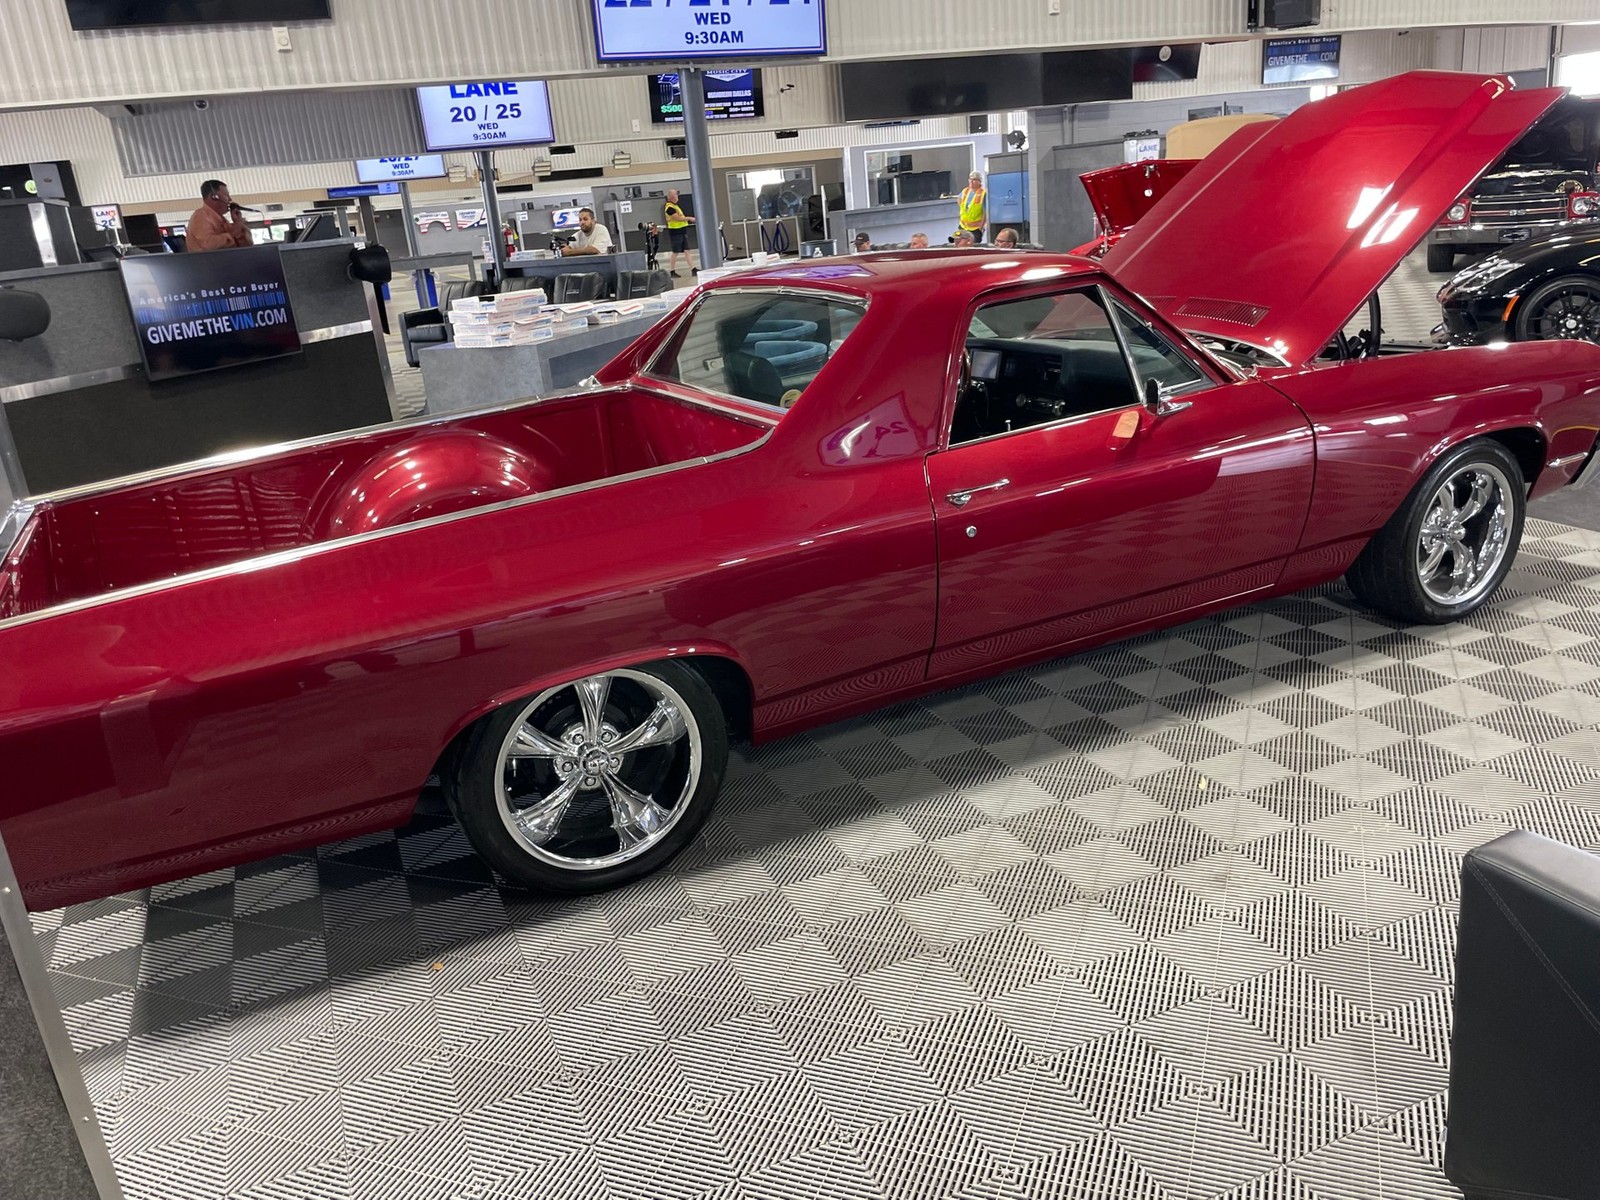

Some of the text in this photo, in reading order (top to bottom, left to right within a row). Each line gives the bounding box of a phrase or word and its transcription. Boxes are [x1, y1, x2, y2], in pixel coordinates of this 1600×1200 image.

[694, 12, 731, 25] WED
[684, 30, 744, 45] 9:30AM
[449, 81, 518, 99] LANE
[449, 105, 476, 123] 20
[495, 102, 522, 119] 25
[477, 122, 499, 131] WED
[472, 131, 507, 141] 9:30AM
[1139, 144, 1158, 153] LANE
[392, 162, 410, 170] WED
[391, 169, 415, 177] 9:30AM
[139, 281, 279, 305] America's Best Car Buyer
[147, 307, 288, 345] GIVEMETHEVIN.COM
